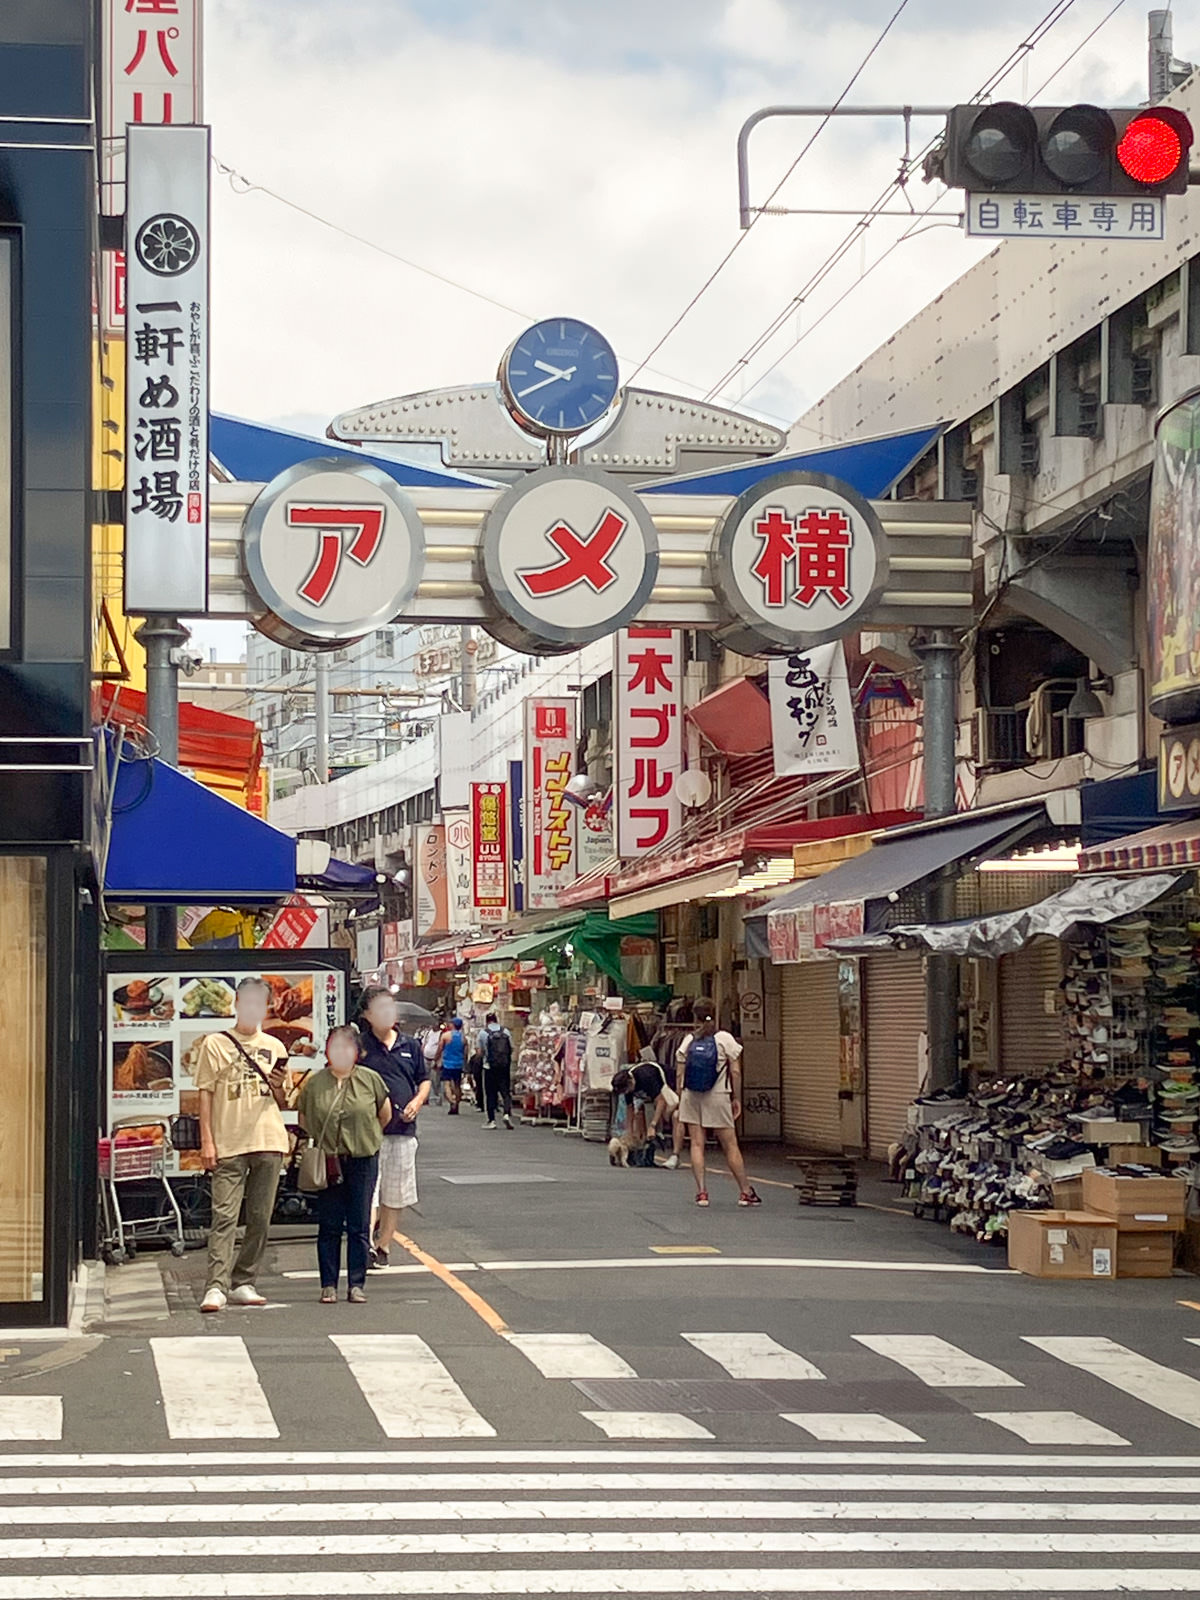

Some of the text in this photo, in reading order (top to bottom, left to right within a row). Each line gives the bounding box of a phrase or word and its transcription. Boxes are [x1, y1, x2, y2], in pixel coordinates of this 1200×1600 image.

[125, 0, 179, 124] パリ
[978, 198, 1156, 232] 自転車専用
[131, 301, 185, 524] 一軒め酒場
[480, 844, 501, 855] UU
